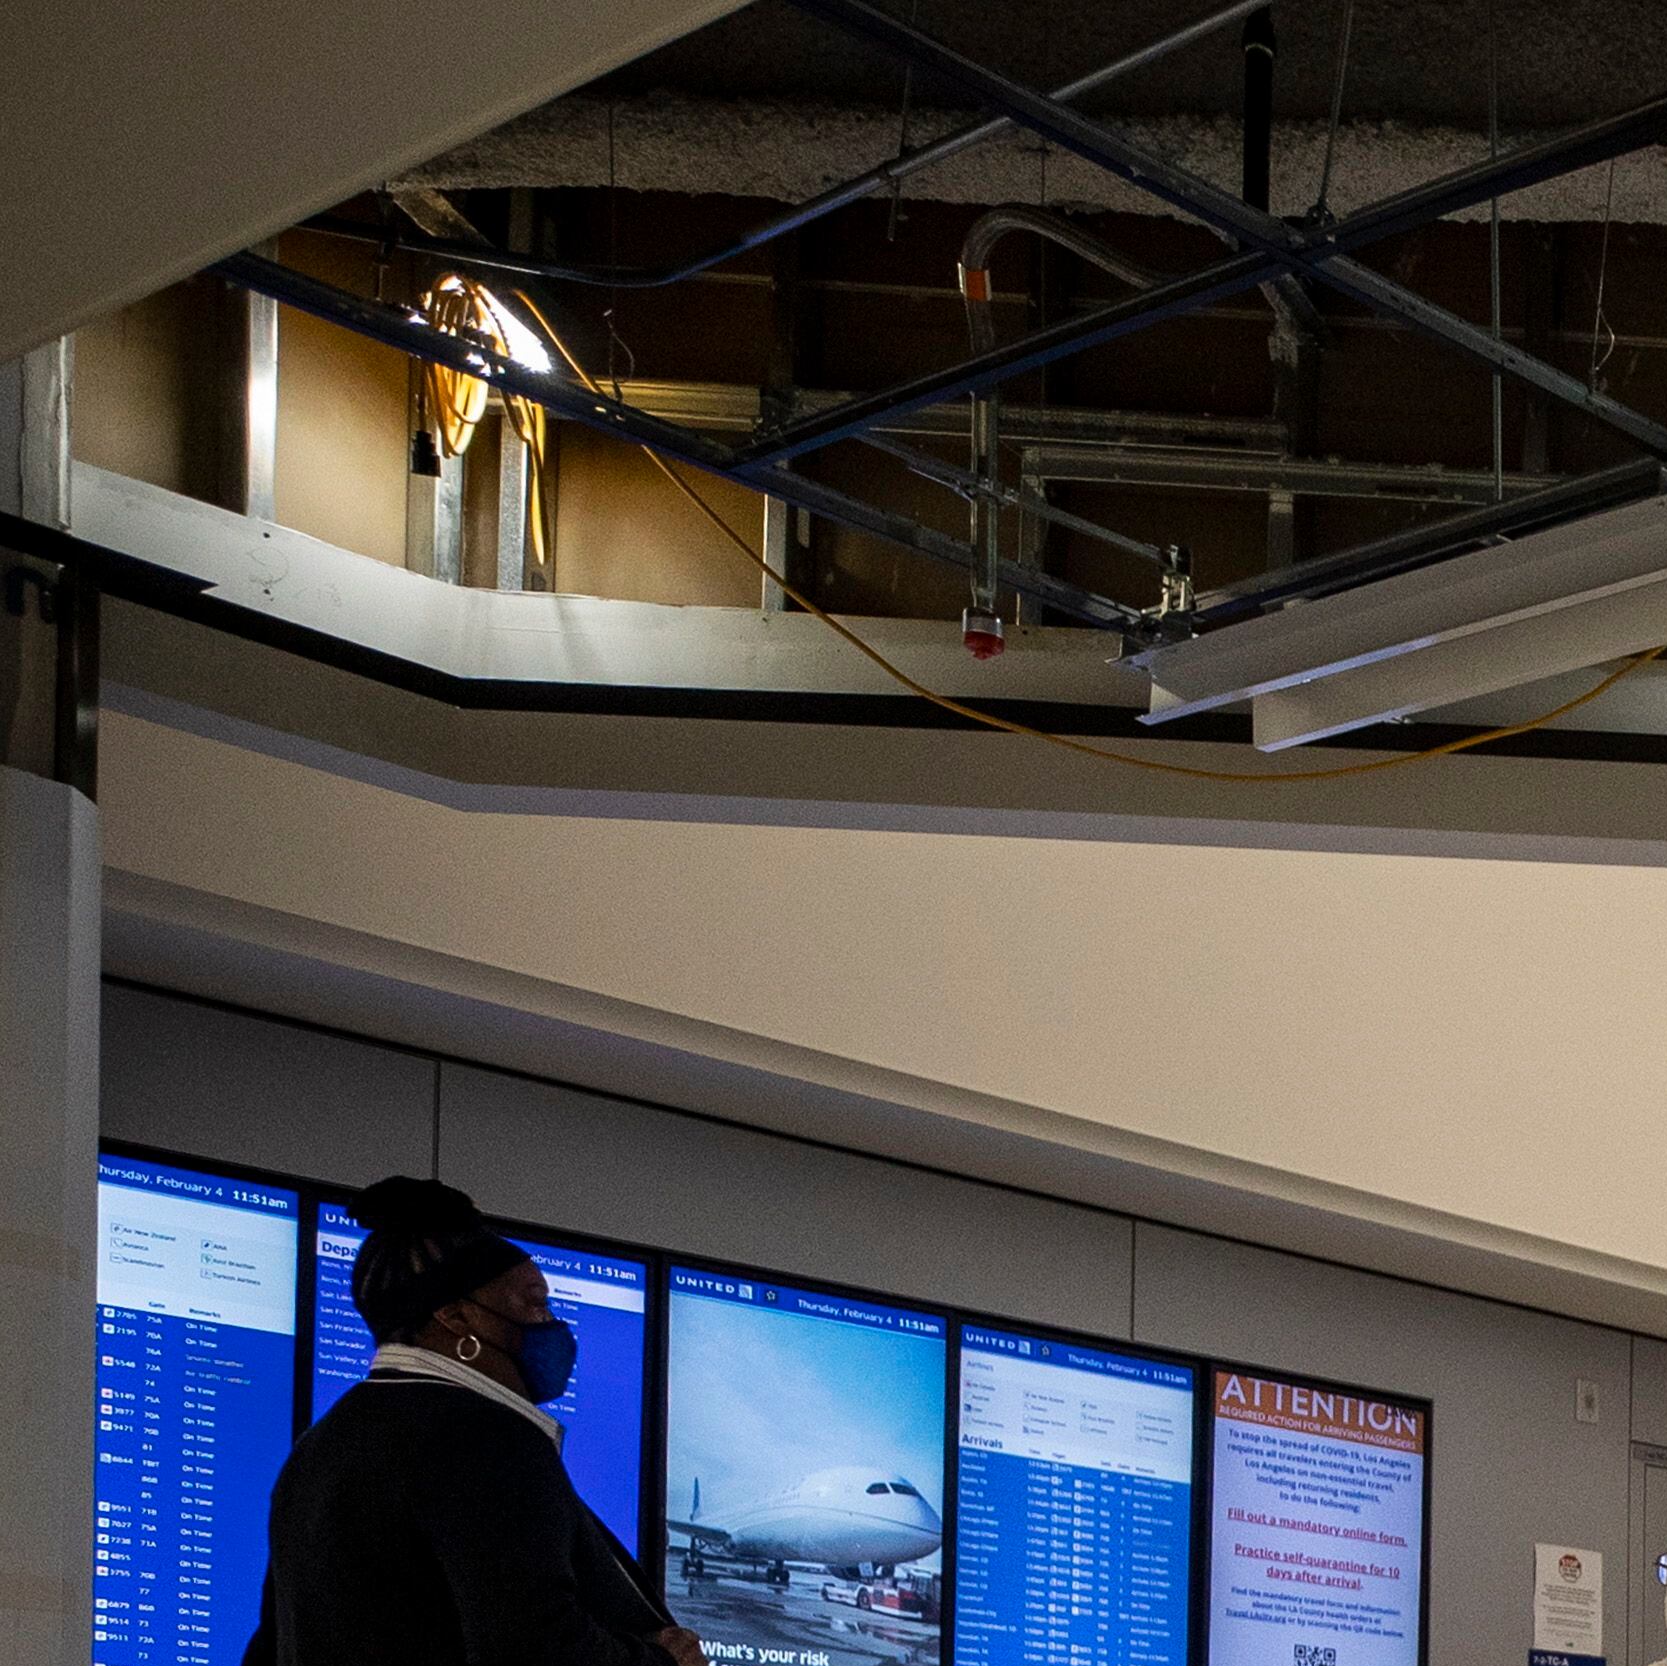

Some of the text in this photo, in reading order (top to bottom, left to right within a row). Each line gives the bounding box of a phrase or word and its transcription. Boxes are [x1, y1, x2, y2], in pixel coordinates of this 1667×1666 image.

[98, 1164, 288, 1209] hursday, February 4 11:51am
[325, 1213, 358, 1227] UNI
[322, 1241, 357, 1258] Depa
[530, 1254, 637, 1282] ebruary 4 11:51am
[676, 1275, 735, 1294] UNITED
[320, 1306, 334, 1314] San
[798, 1298, 940, 1334] Thursday, February 4 11:51am
[320, 1321, 333, 1329] San
[334, 1340, 366, 1350] Salvador
[966, 1332, 1016, 1350] UNITED
[318, 1352, 332, 1360] Sun
[1106, 1361, 1140, 1376] February
[1152, 1370, 1188, 1385] 11:51am
[1221, 1374, 1417, 1437] ATTENTION
[1219, 1404, 1416, 1449] REQUIRED ACTION FOR ARRIVING PASSENGERS
[962, 1434, 1004, 1450] Arrivals
[1228, 1429, 1411, 1471] To stop the spread of COVID-19, Los Angeles
[1227, 1442, 1412, 1482] requires all travelers entering the County of
[1244, 1458, 1394, 1494] Los Angeles on non-essential travel,
[1256, 1474, 1381, 1504] including returning residents,
[1279, 1491, 1289, 1500] to
[1290, 1492, 1302, 1502] do
[1304, 1494, 1318, 1505] the
[1228, 1508, 1245, 1521] Fill
[1247, 1511, 1266, 1524] out
[1279, 1518, 1340, 1537] mandatory
[1342, 1526, 1376, 1542] online
[1378, 1531, 1409, 1548] form.
[1234, 1543, 1400, 1580] Practice self-quarantine for 10
[1266, 1566, 1364, 1591] days after arrival.
[1231, 1586, 1248, 1596] Find
[1249, 1588, 1262, 1598] the
[1262, 1590, 1302, 1605] mandatory
[1345, 1601, 1358, 1610] and
[1360, 1602, 1400, 1616] information
[1252, 1600, 1273, 1610] about
[1274, 1604, 1287, 1612] the
[1288, 1605, 1298, 1614] LA
[1300, 1606, 1324, 1619] County
[1326, 1610, 1348, 1620] health
[1340, 1622, 1352, 1632] the
[699, 1640, 754, 1661] What's
[758, 1649, 796, 1665] your
